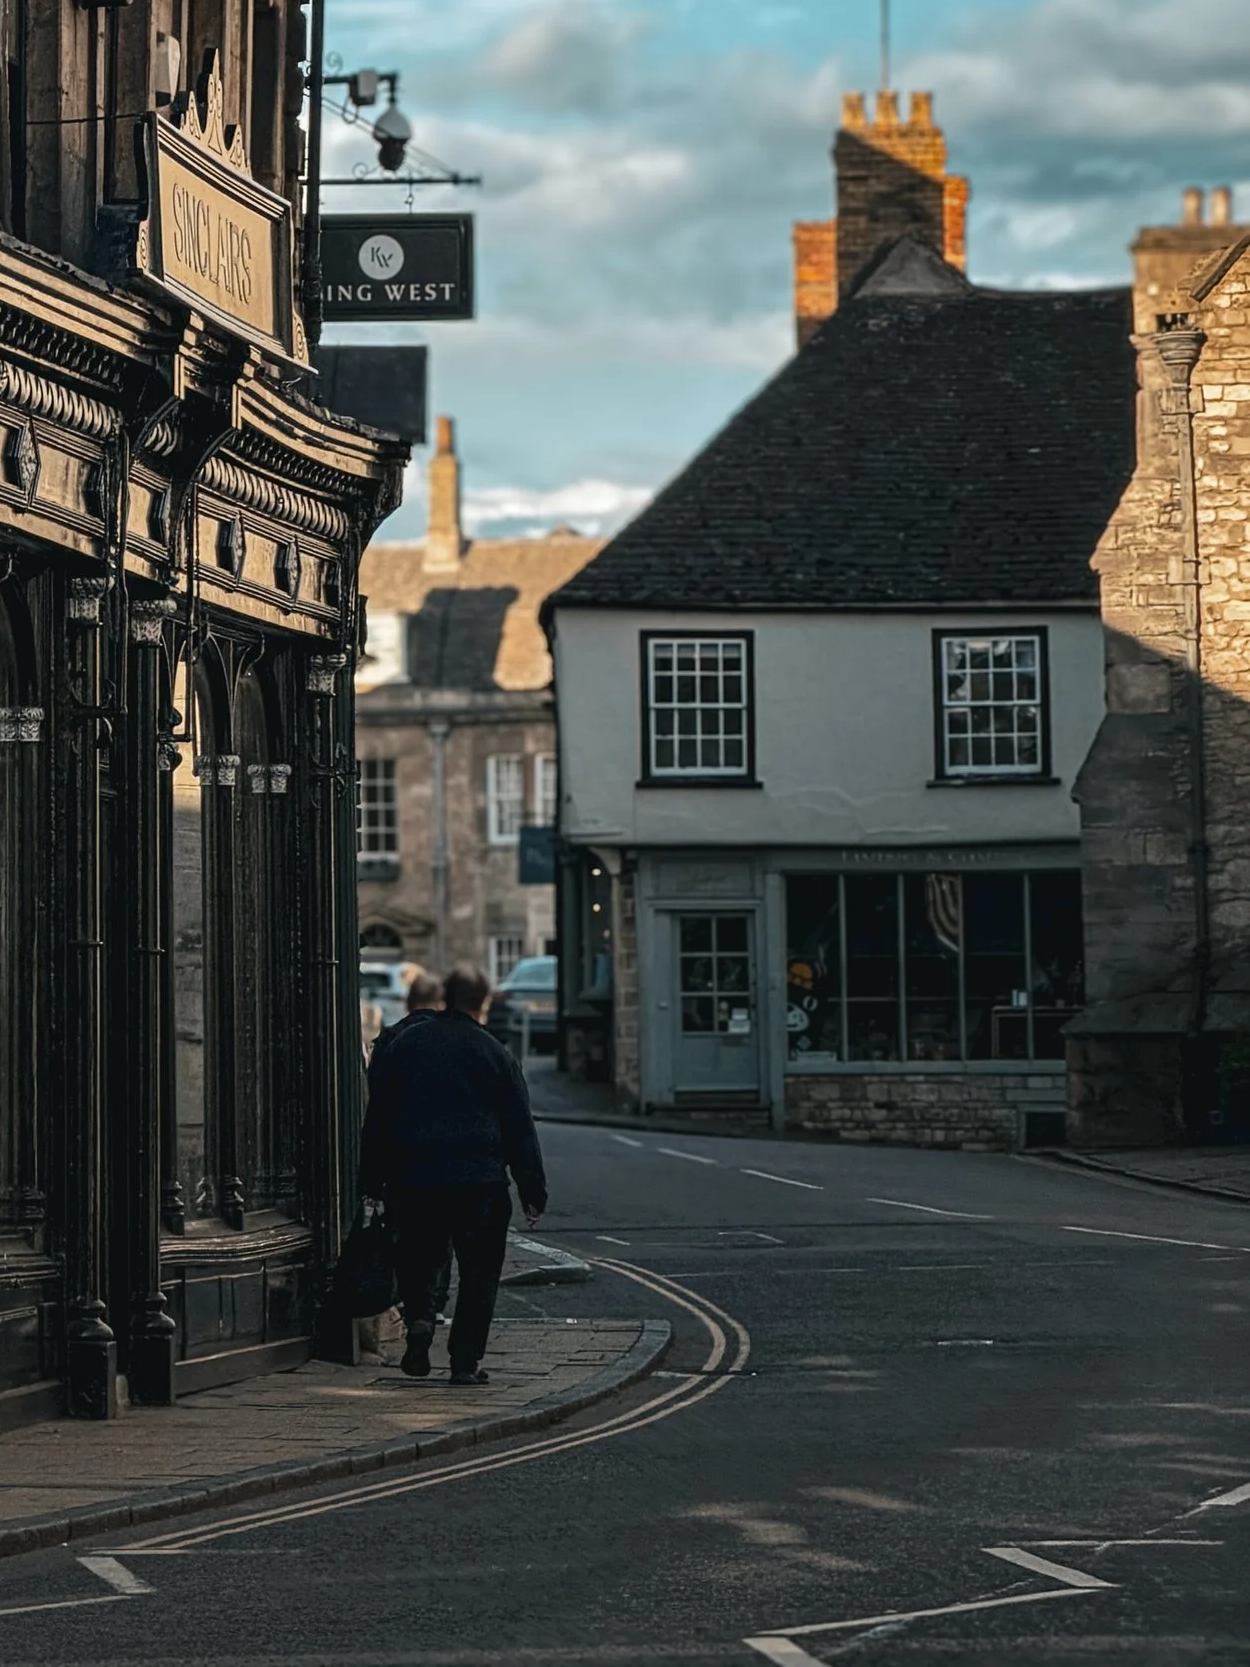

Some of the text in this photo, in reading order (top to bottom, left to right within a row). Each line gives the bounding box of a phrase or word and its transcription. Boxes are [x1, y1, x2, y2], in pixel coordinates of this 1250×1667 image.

[172, 182, 252, 305] SINCLAIRS
[325, 284, 455, 302] ING WEST
